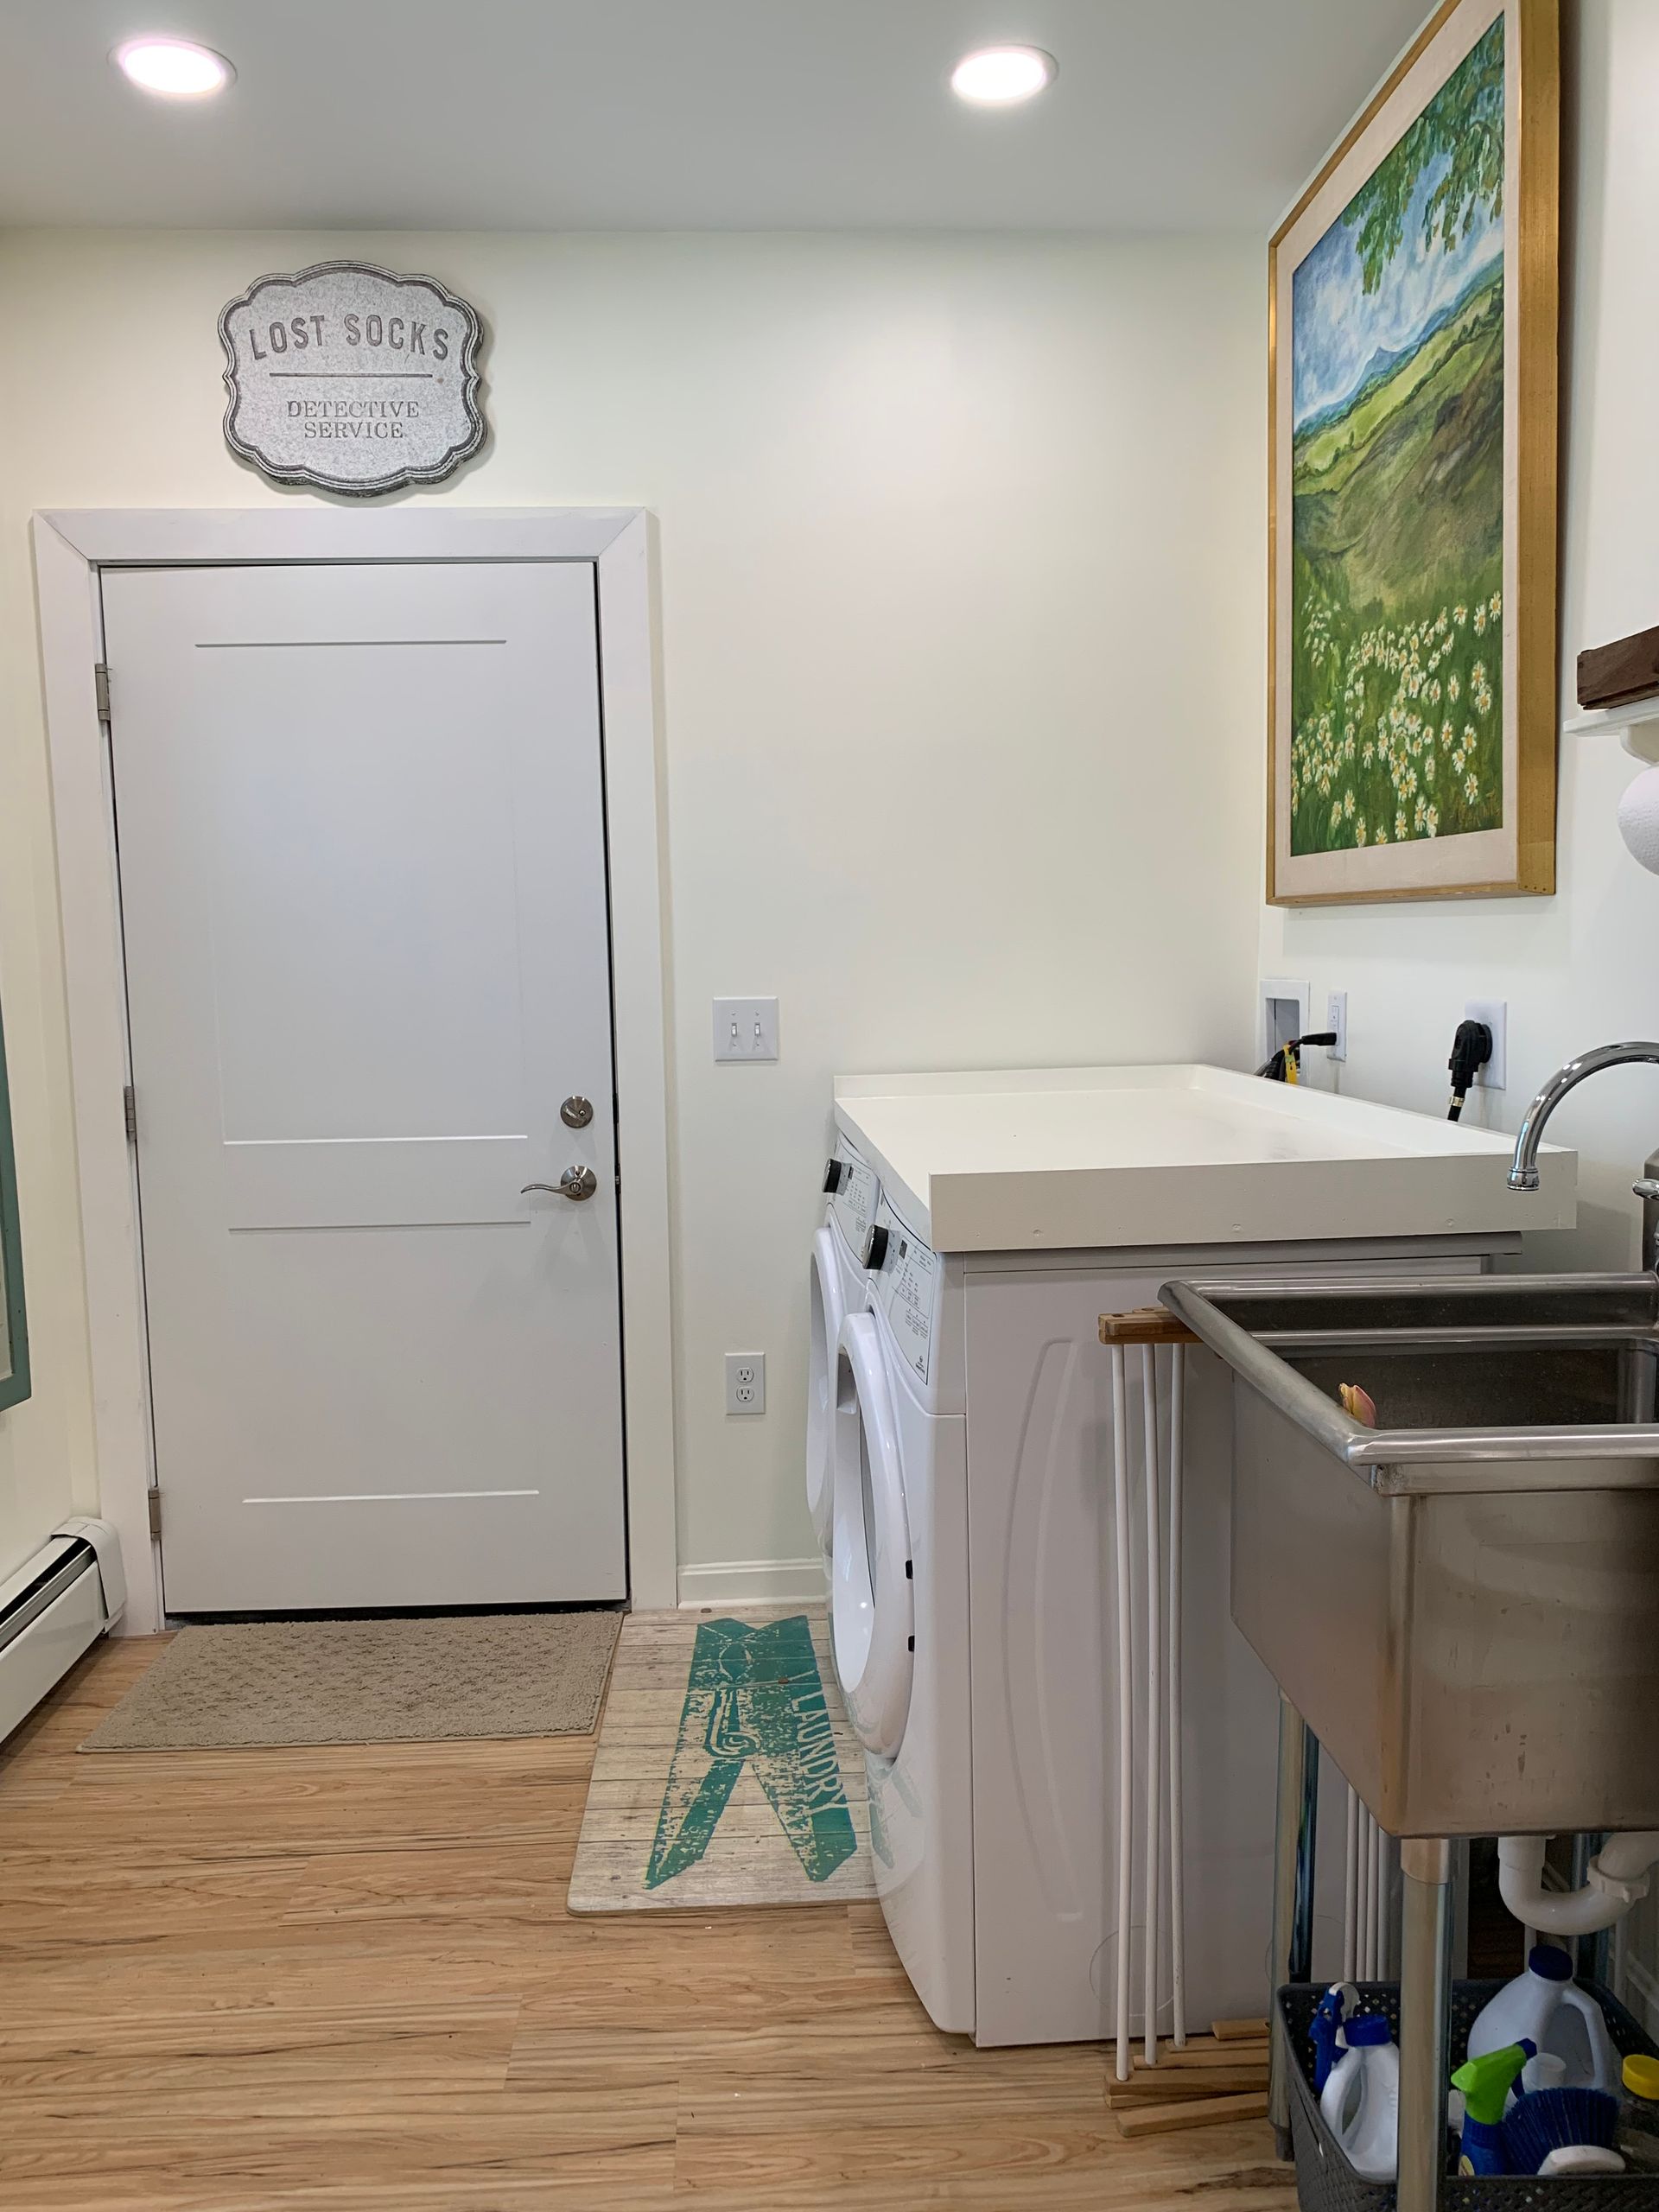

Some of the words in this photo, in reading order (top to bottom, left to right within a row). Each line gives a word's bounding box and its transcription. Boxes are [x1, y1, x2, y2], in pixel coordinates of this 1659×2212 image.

[249, 315, 326, 360] LOST
[344, 314, 448, 360] SOCKS
[287, 400, 419, 418] DETECTIVE
[304, 422, 404, 439] SERVICE
[791, 1690, 849, 1815] LAUNDRY
